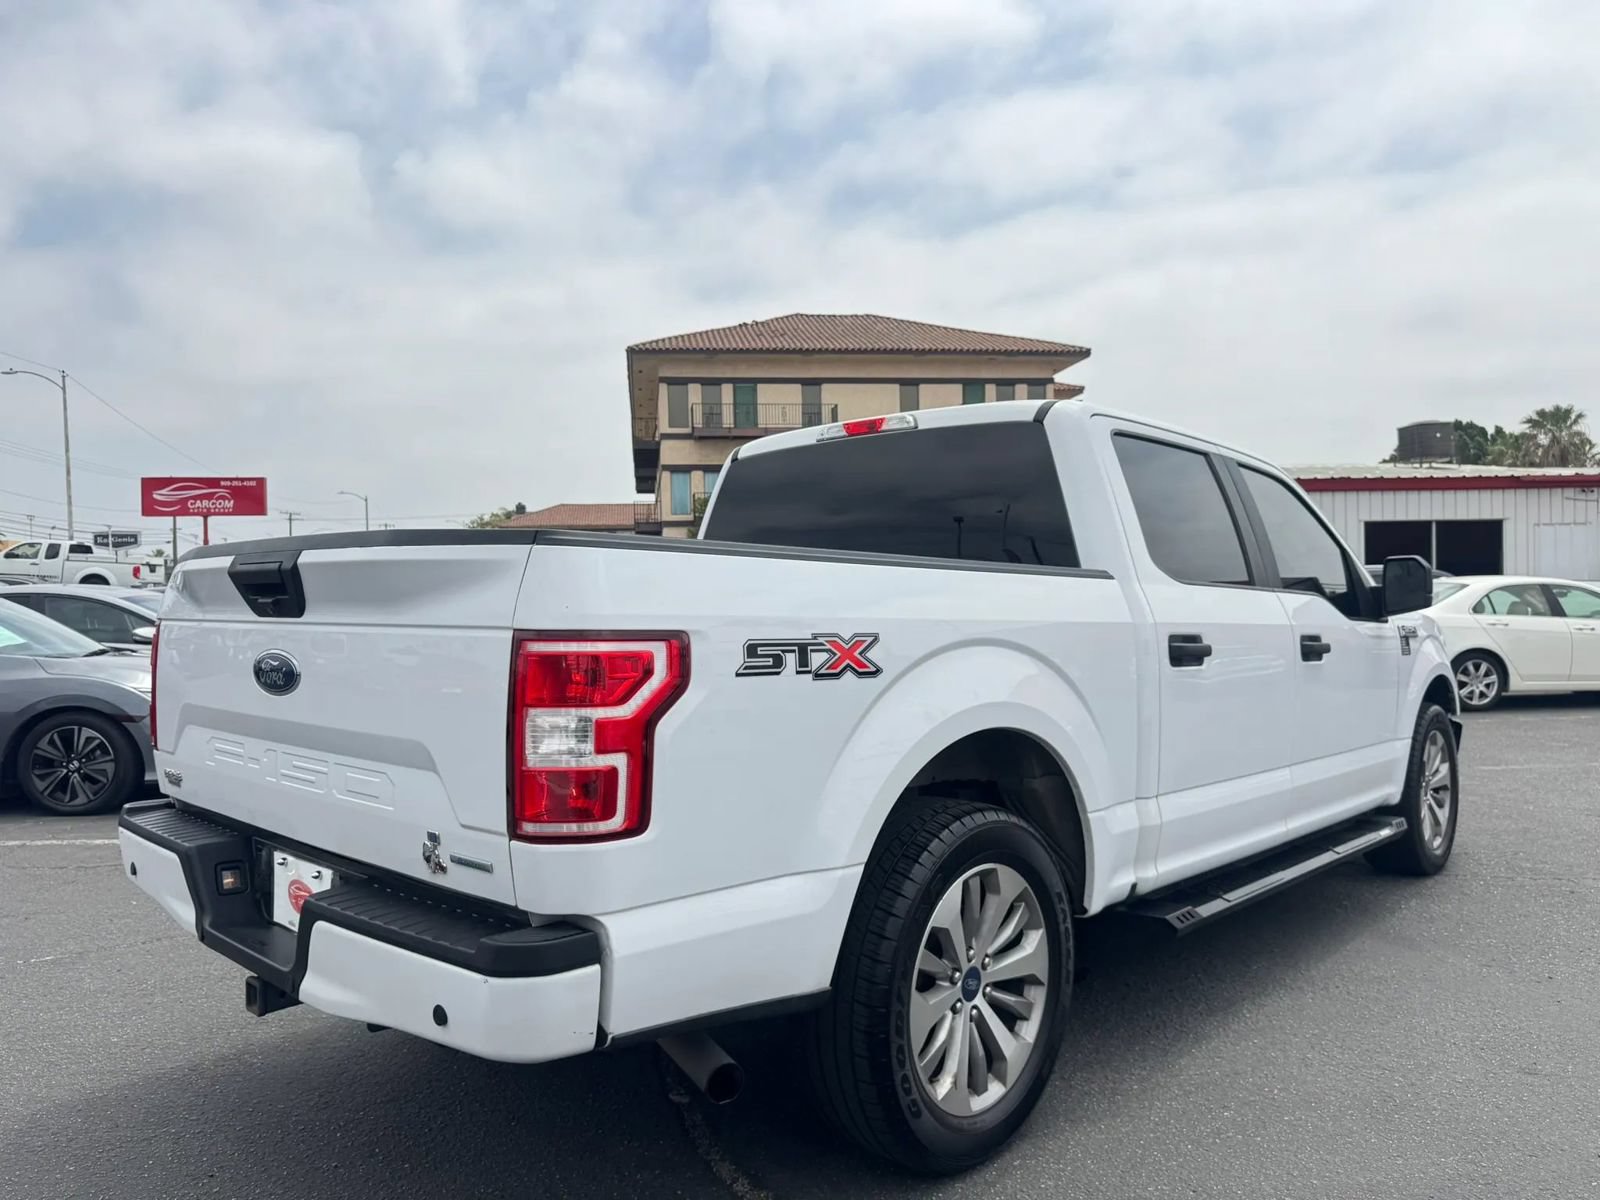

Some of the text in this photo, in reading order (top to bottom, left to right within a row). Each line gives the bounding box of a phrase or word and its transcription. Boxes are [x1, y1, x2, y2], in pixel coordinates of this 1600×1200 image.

[187, 499, 234, 508] CARCOM
[259, 658, 286, 685] Ford
[735, 633, 883, 681] STX
[205, 736, 395, 810] F-150
